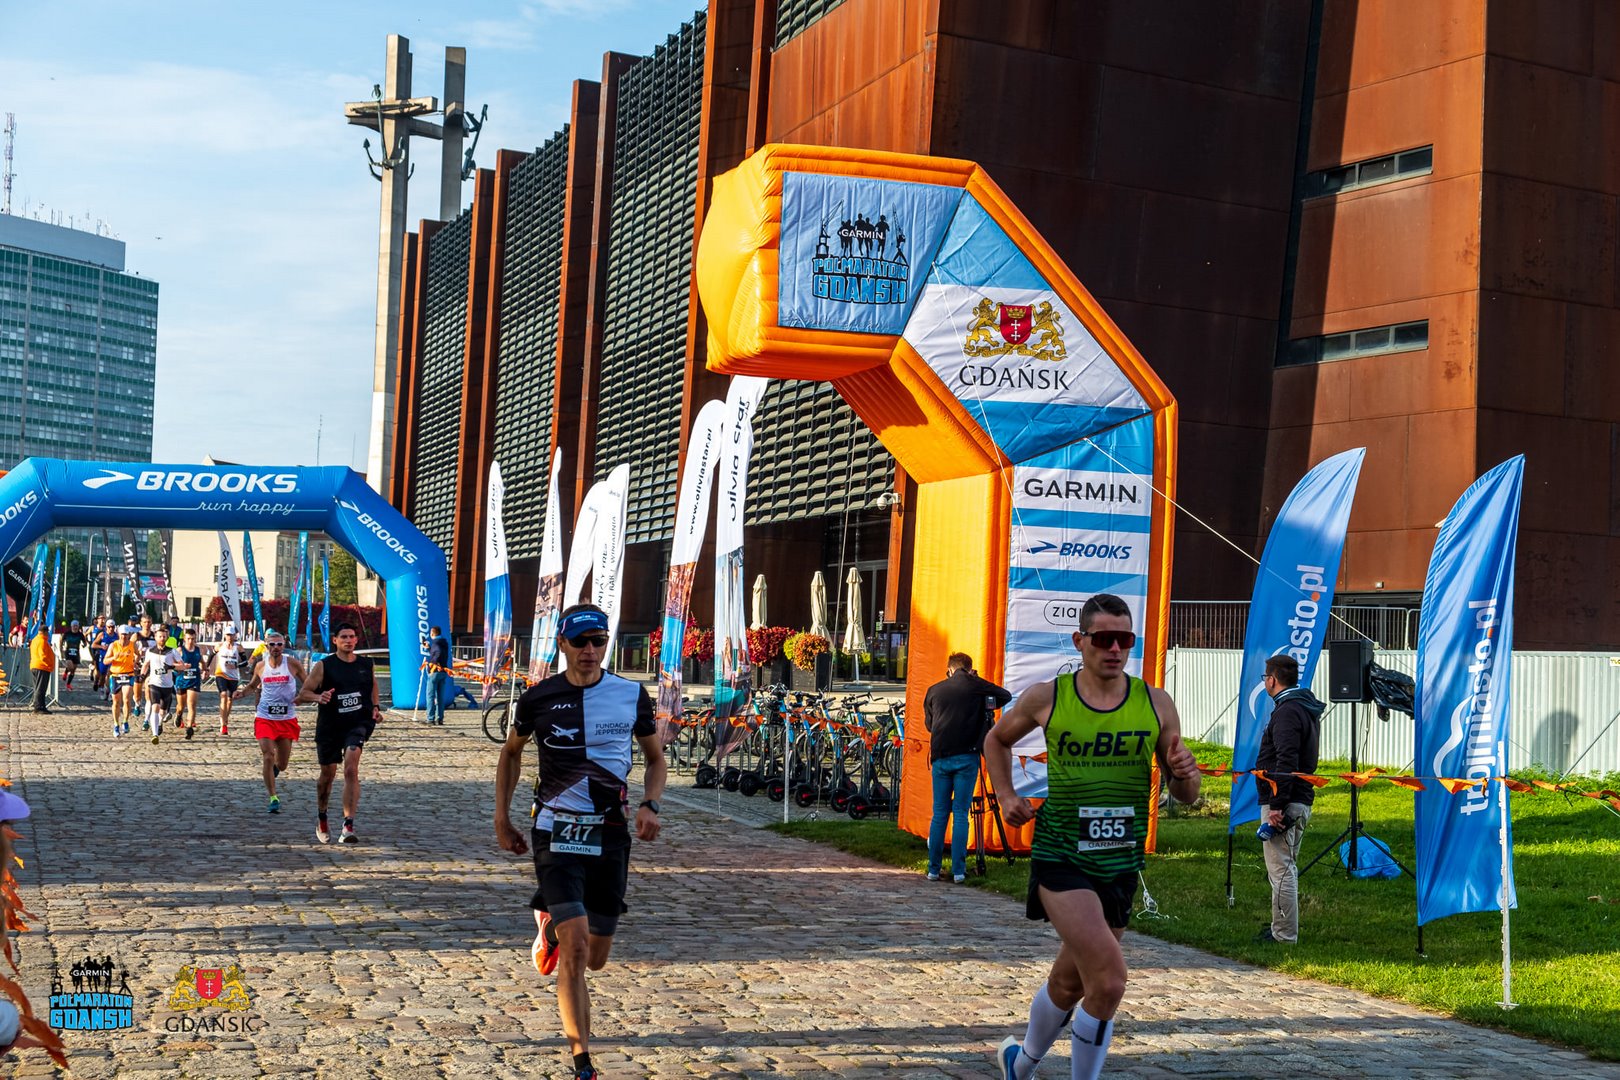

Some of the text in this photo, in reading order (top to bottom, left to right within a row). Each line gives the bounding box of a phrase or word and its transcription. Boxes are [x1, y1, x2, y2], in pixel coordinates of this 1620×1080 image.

[841, 229, 884, 240] GARMIN
[959, 364, 1069, 391] GDAŃSK
[136, 471, 298, 493] BROOKS
[1024, 478, 1137, 504] GARMIN
[199, 499, 295, 516] run happy
[357, 512, 418, 564] BROOKS
[1059, 542, 1132, 560] BROOKS
[270, 706, 285, 714] 254
[342, 697, 359, 707] 680
[1057, 731, 1152, 757] forBET
[560, 823, 594, 841] 417
[1089, 819, 1126, 839] 655
[559, 845, 592, 853] GARMIN
